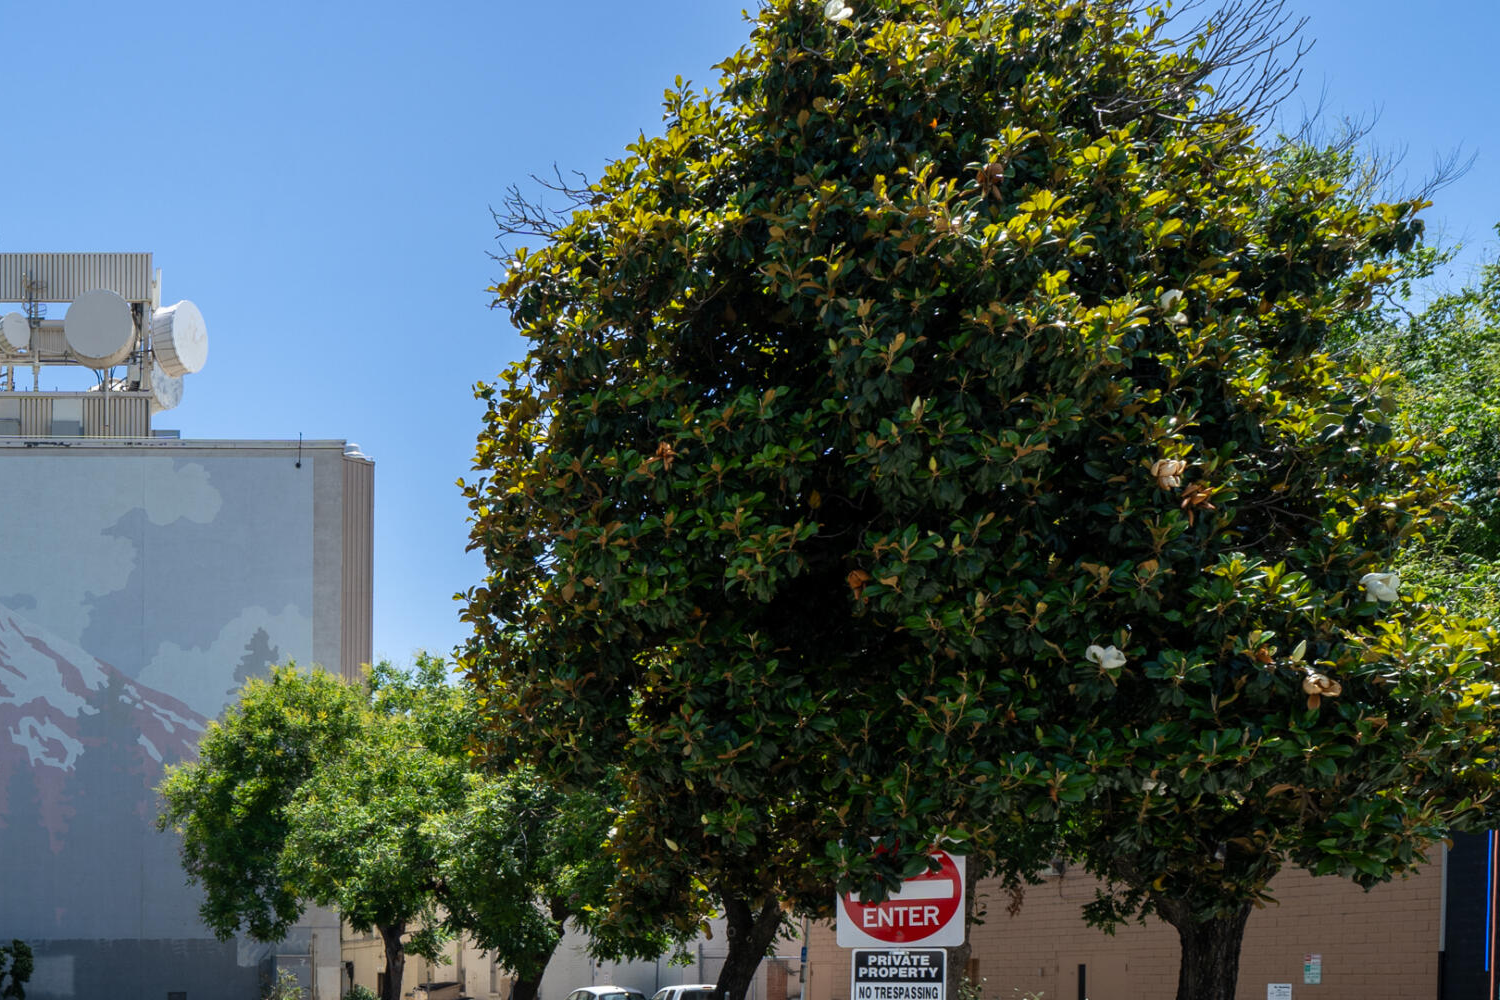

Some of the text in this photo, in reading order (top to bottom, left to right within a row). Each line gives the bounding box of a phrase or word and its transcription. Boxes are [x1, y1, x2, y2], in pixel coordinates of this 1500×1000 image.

[863, 905, 940, 928] ENTER
[868, 955, 930, 966] PRIVATE
[858, 967, 939, 978] PROPERTY
[858, 986, 939, 1000] NO TRESPASSING
